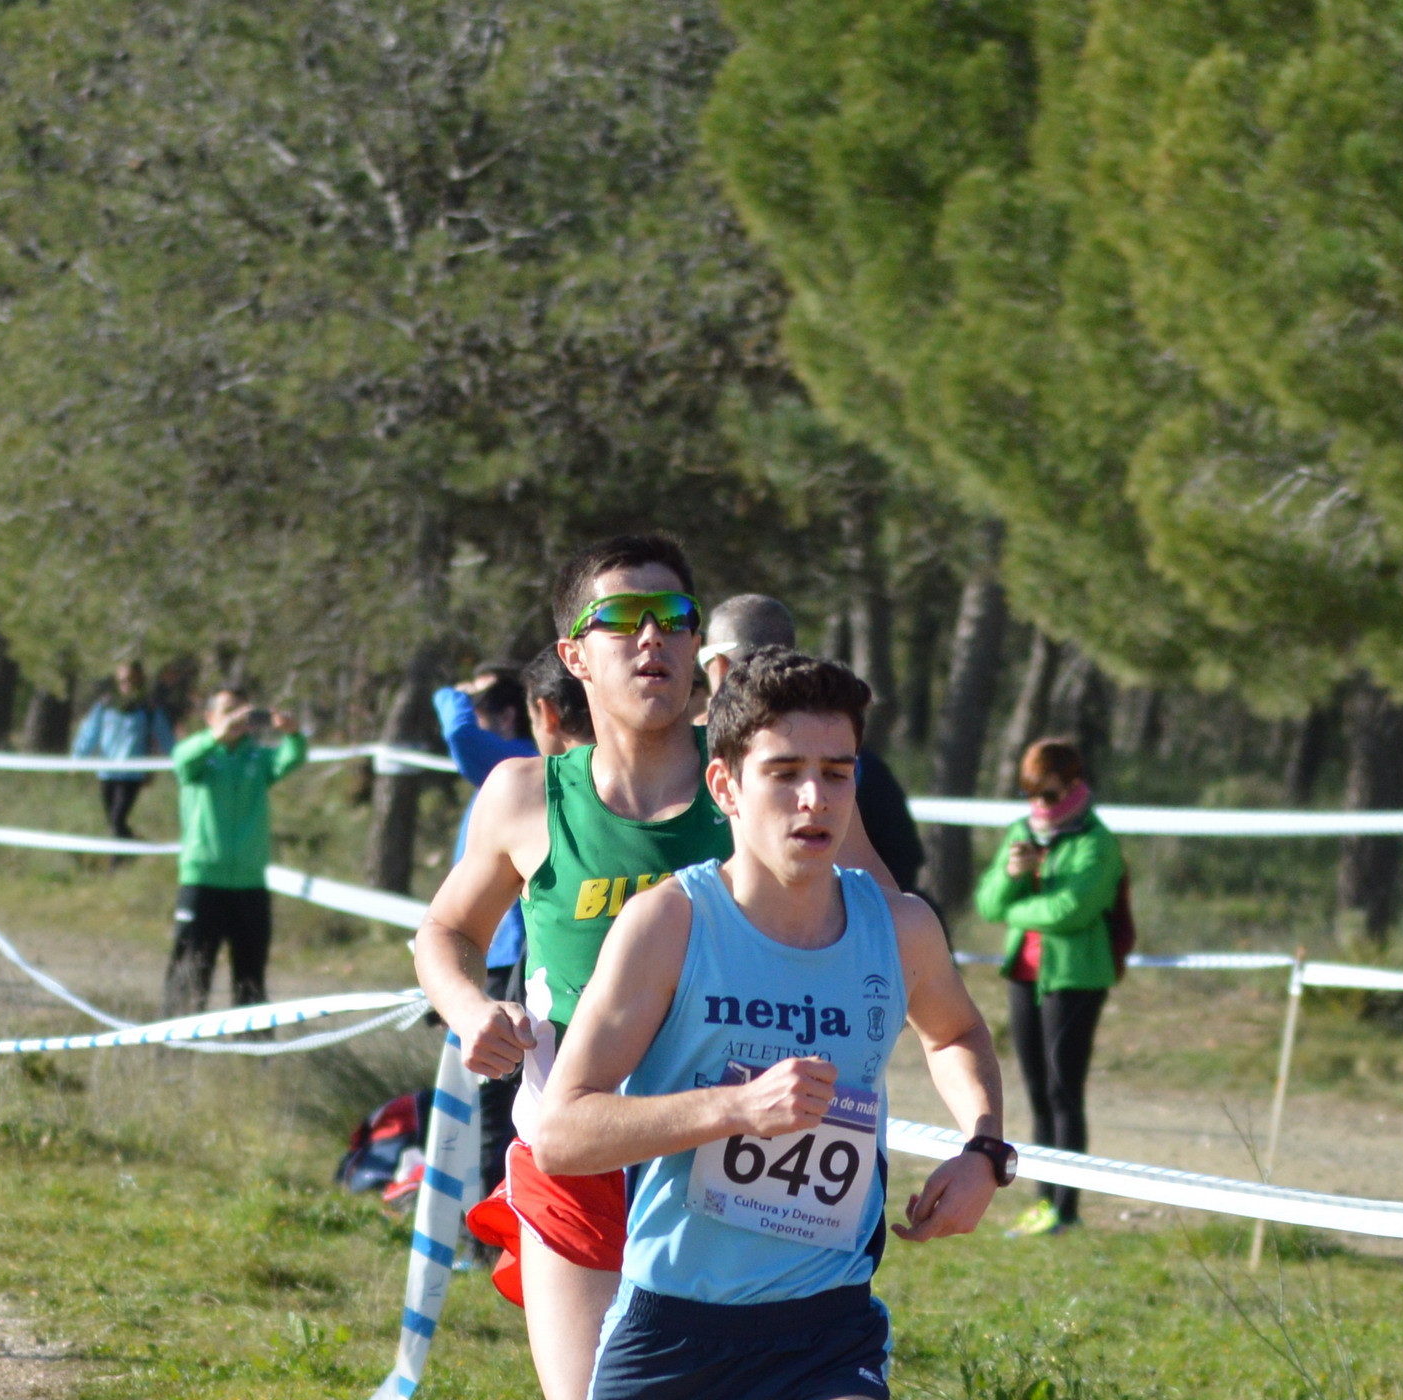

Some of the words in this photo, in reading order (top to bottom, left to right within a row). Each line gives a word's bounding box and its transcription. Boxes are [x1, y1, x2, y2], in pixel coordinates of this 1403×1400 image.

[704, 994, 852, 1046] nerja
[840, 1096, 855, 1111] de
[722, 1133, 860, 1207] 649
[734, 1195, 779, 1215] Cultura
[782, 1208, 790, 1219] y
[792, 1208, 841, 1228] Deportes
[760, 1217, 816, 1239] Deportes
